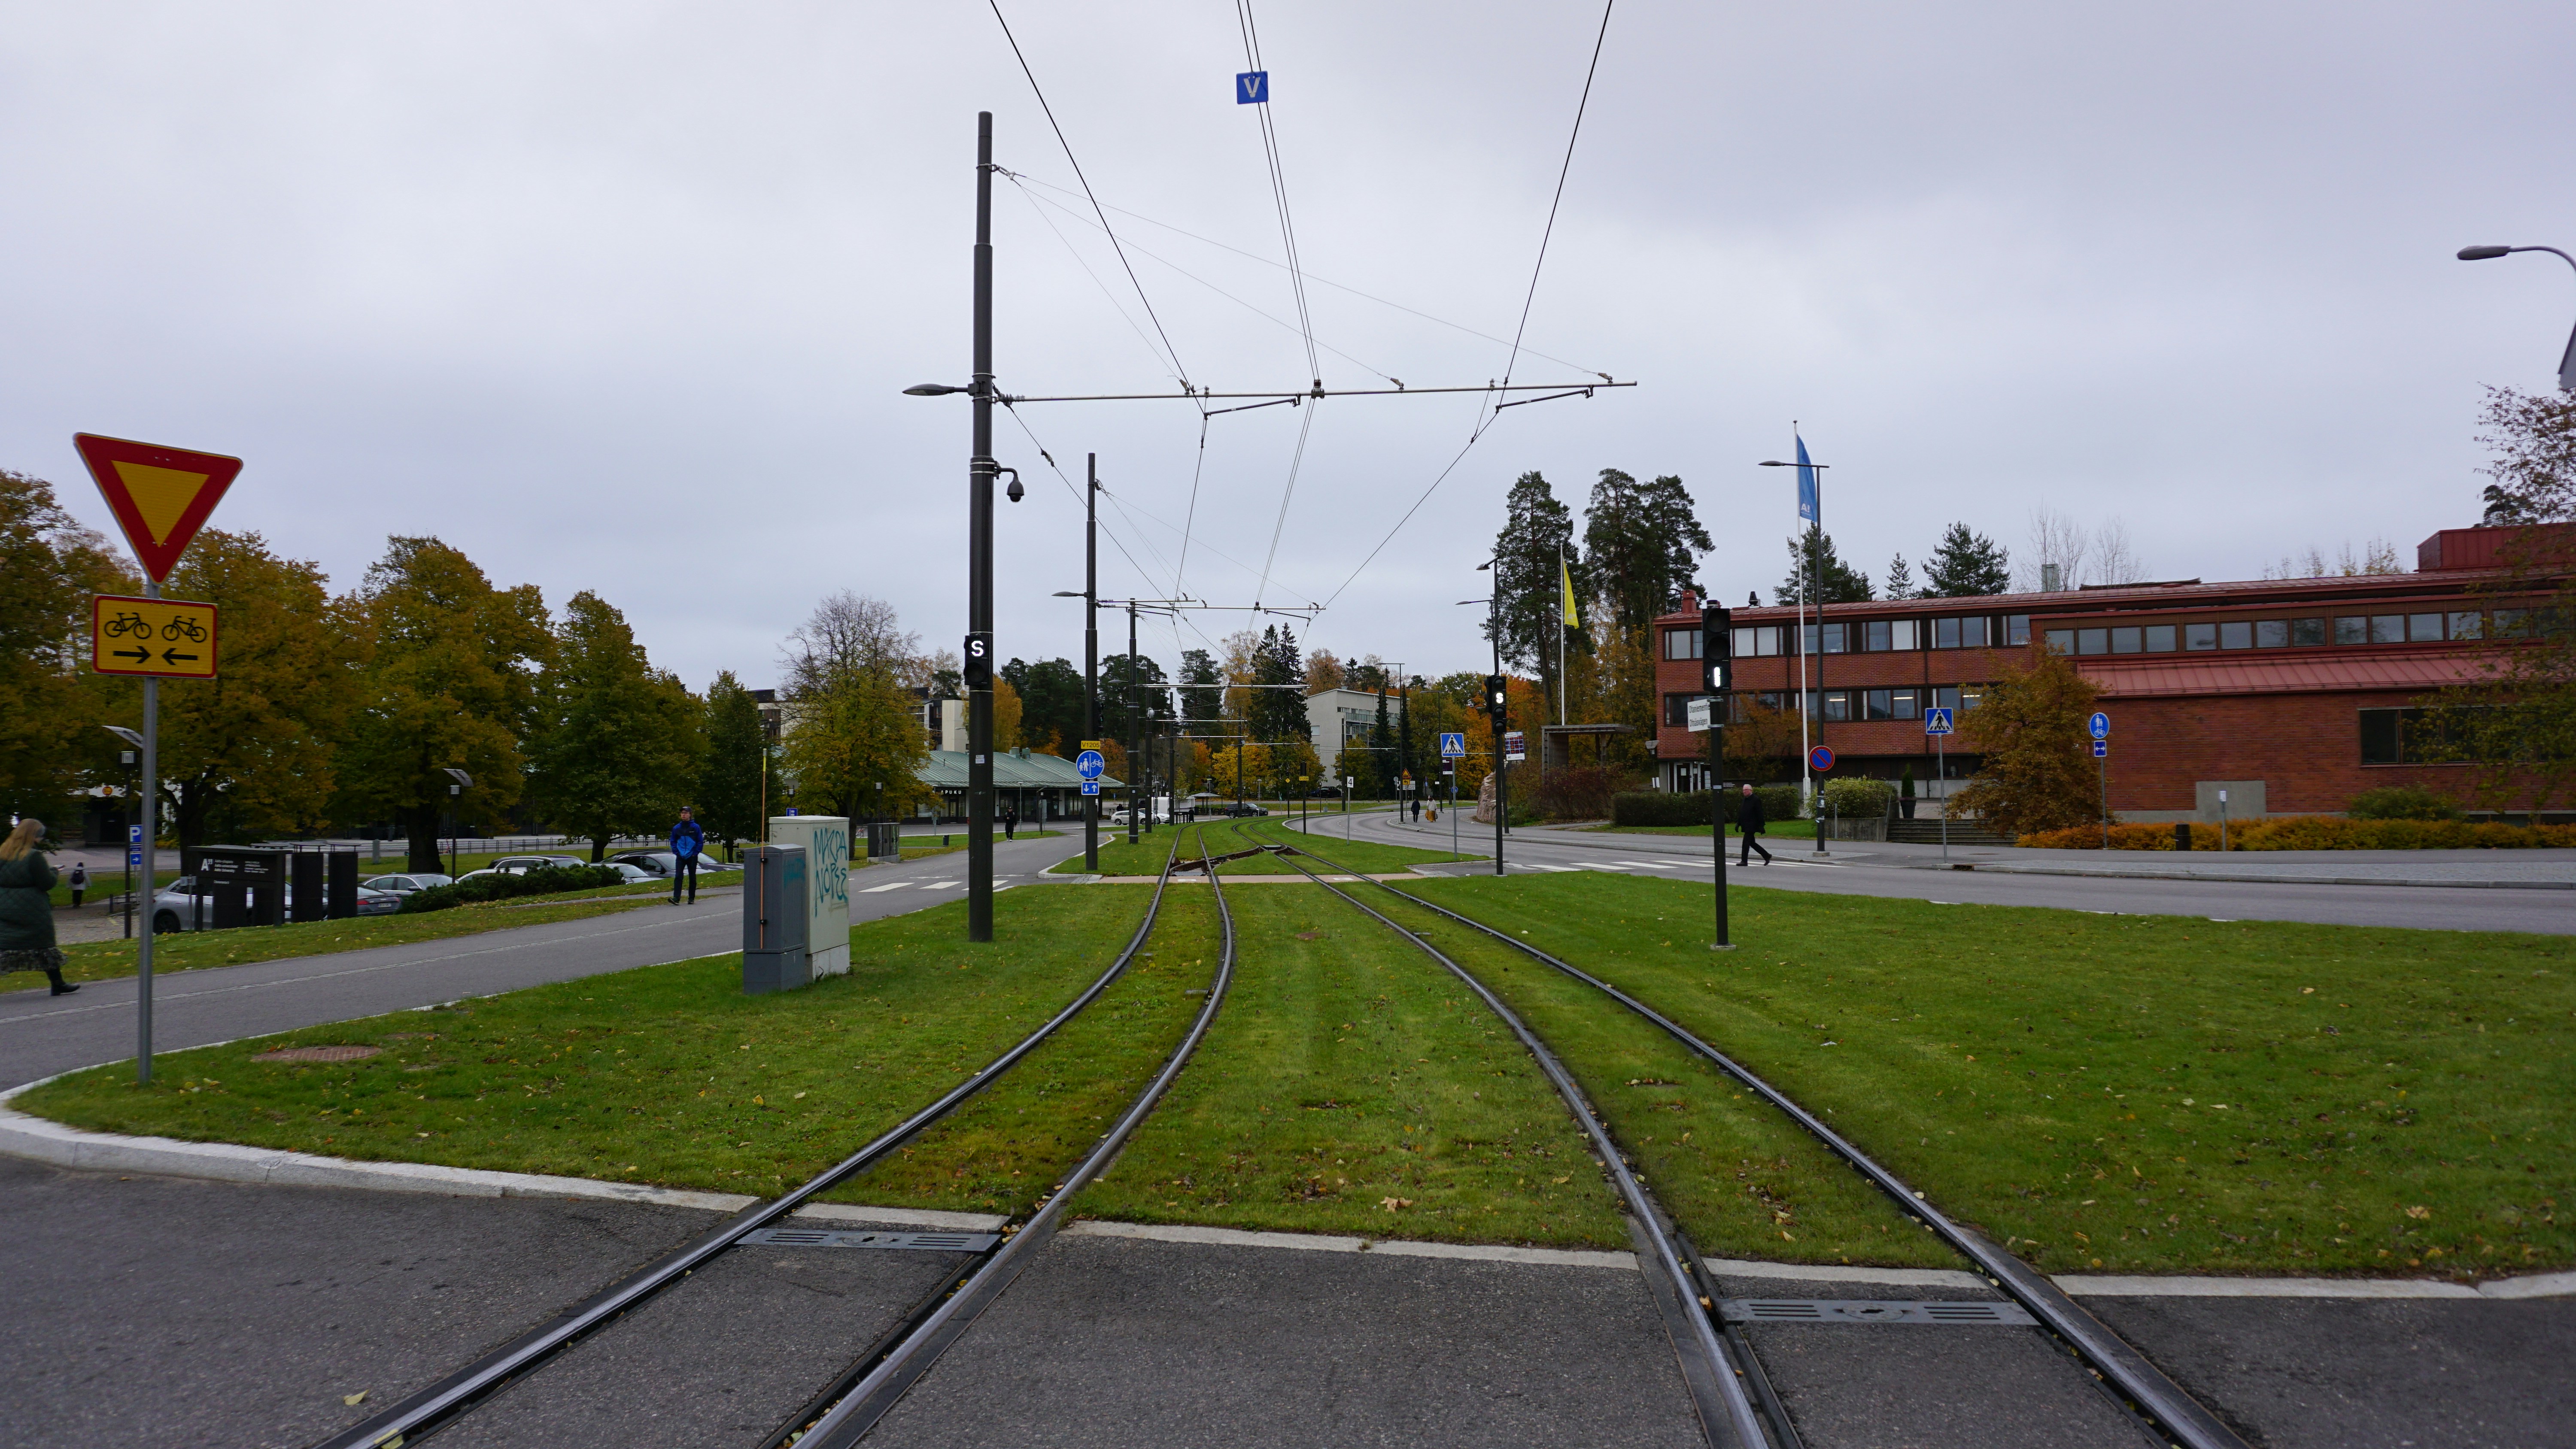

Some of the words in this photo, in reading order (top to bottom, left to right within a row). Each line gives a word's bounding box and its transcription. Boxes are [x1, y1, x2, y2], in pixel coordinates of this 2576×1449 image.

[1243, 77, 1261, 98] V
[971, 640, 984, 657] S
[1496, 692, 1504, 703] S
[1348, 778, 1352, 786] 4
[130, 827, 141, 842] P
